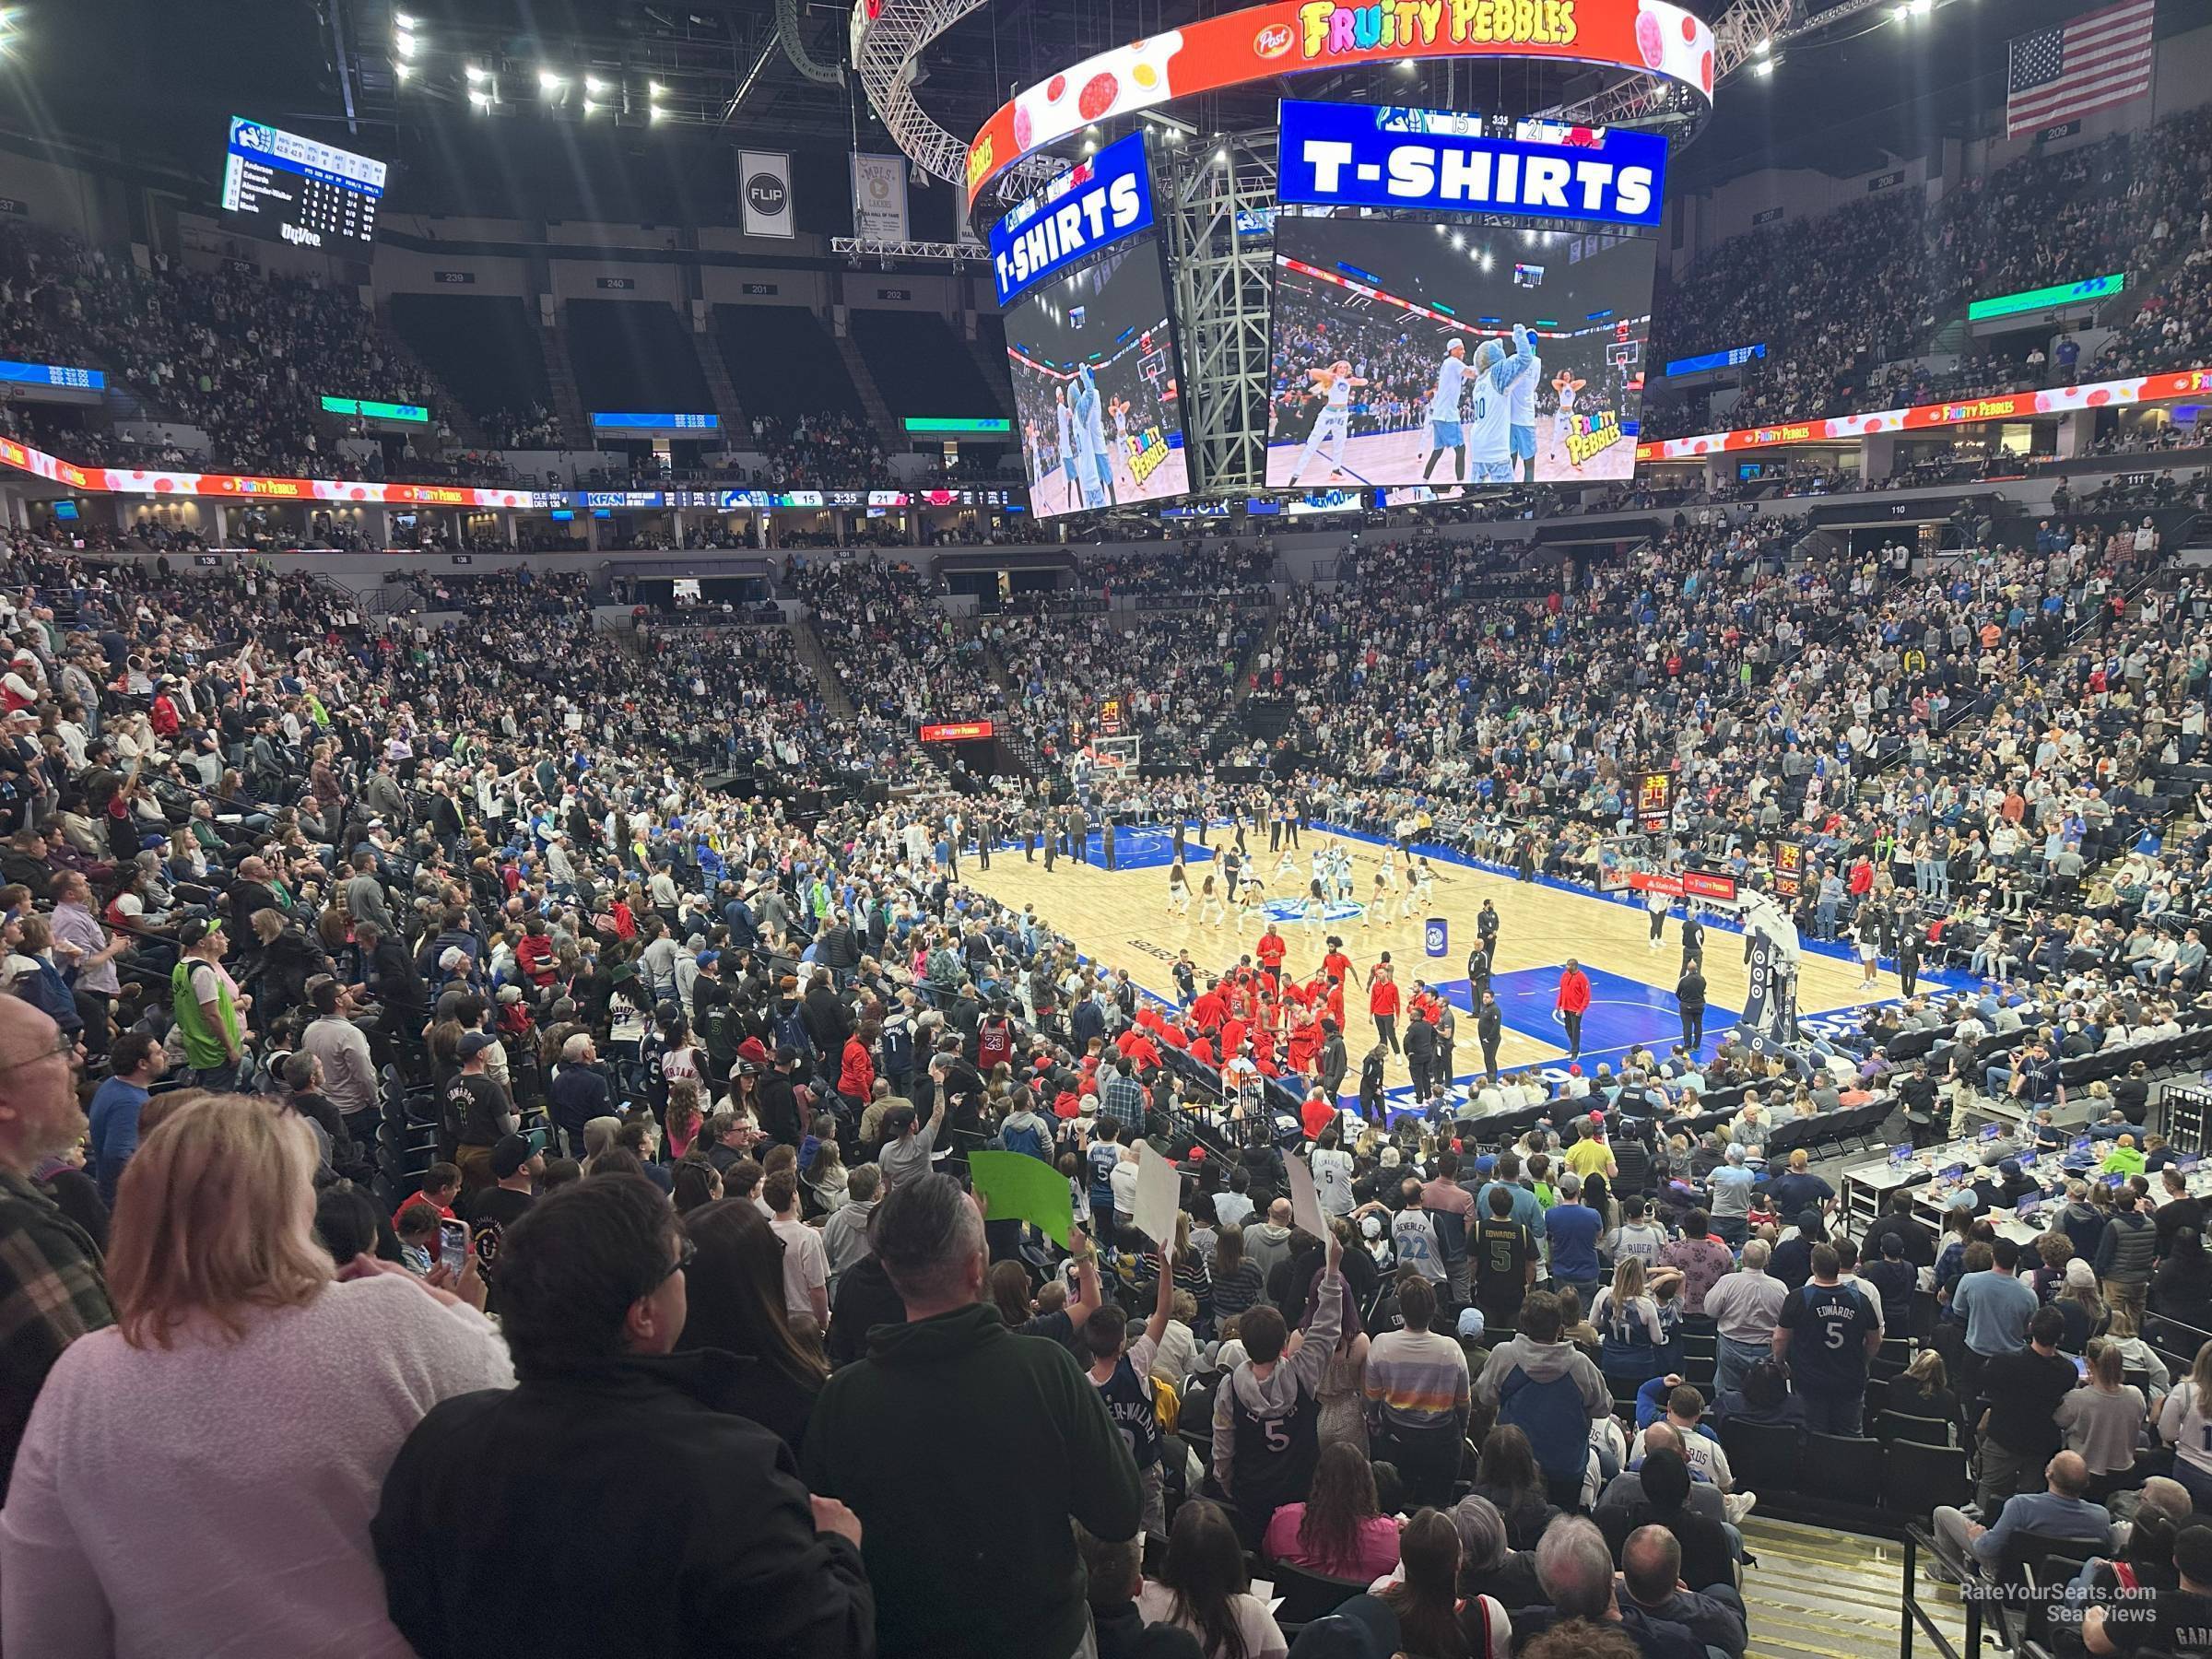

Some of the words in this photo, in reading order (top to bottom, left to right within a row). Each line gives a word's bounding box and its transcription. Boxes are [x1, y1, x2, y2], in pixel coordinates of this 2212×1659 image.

[1451, 0, 1578, 45] PEBBLES
[1259, 29, 1287, 49] Post
[1451, 112, 1468, 134] 15
[1492, 115, 1508, 124] 3:35
[1526, 119, 1543, 140] 21
[2048, 124, 2068, 138] 209
[1303, 140, 1653, 215] T-SHIRTS
[751, 188, 782, 201] FLIP
[1760, 211, 1775, 222] 207
[996, 172, 1139, 294] T-SHIRTS
[445, 273, 464, 283] 239
[607, 279, 624, 288] 240
[752, 286, 768, 294] 201
[887, 291, 901, 300] 202
[1979, 400, 2014, 416] PEBBLES
[1783, 427, 1809, 441] PEBBLES
[1566, 423, 1621, 465] PEBBLES
[1128, 438, 1170, 485] PEBBLES
[2127, 475, 2145, 484] 111
[587, 492, 625, 506] KFAN
[803, 495, 815, 504] 15
[834, 494, 857, 503] 3:35
[877, 495, 888, 503] 21
[1891, 505, 1905, 514] 110
[202, 557, 216, 565] 136
[1102, 709, 1118, 722] 24
[1647, 775, 1667, 789] 3:35
[1642, 788, 1665, 809] 24
[1783, 847, 1799, 858] 3:35
[1783, 856, 1795, 868] 24
[1655, 882, 1669, 891] State
[1126, 939, 1179, 960] CENTER
[712, 1019, 722, 1035] 5
[890, 1037, 897, 1053] 1
[985, 1036, 1004, 1051] 23
[650, 1062, 660, 1085] 5
[447, 1088, 476, 1105] EDWARDS
[1098, 1164, 1109, 1182] 5
[1326, 1170, 1334, 1184] 5
[1396, 1221, 1427, 1233] BEVERLEY
[1485, 1230, 1516, 1239] EDWARDS
[1399, 1236, 1429, 1259] 22
[1628, 1244, 1653, 1254] RIDER
[1490, 1241, 1512, 1272] 5
[1816, 1306, 1855, 1321] EDWARDS
[1824, 1323, 1843, 1349] 5
[1265, 1419, 1290, 1453] 5
